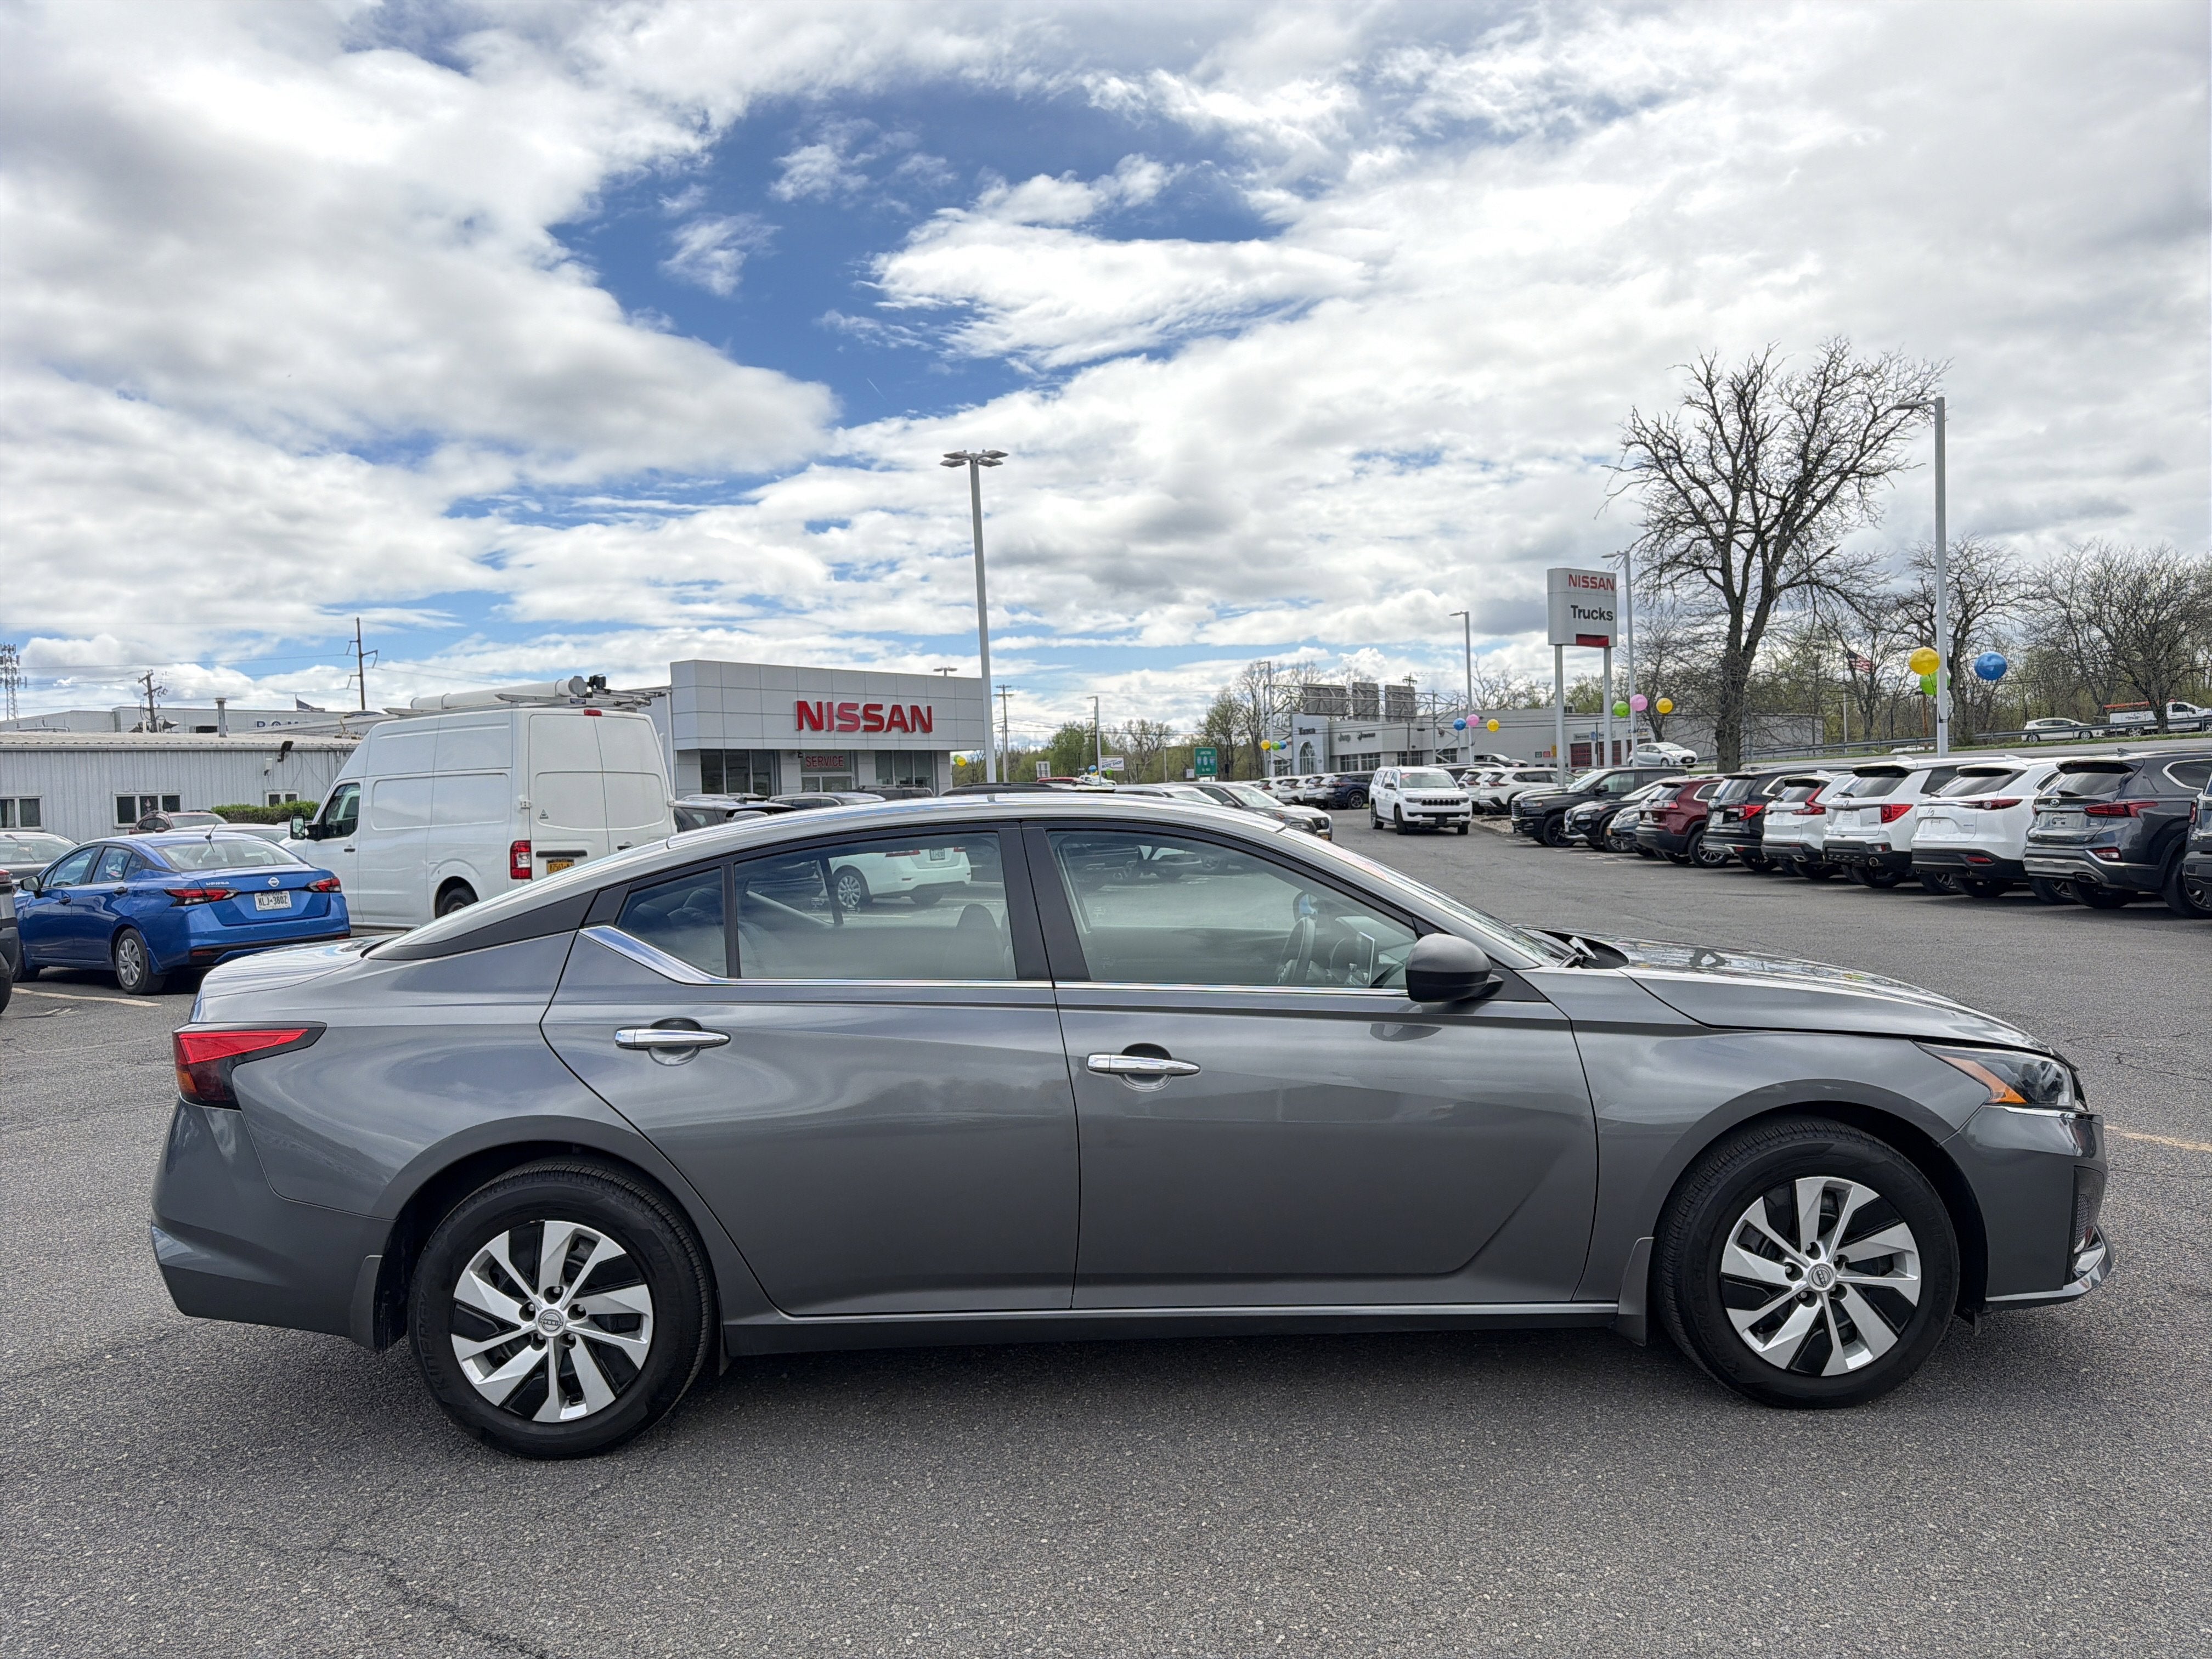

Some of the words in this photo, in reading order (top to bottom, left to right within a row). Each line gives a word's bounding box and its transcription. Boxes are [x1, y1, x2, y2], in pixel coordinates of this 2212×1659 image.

[1568, 574, 1615, 591] NISSAN
[1571, 605, 1613, 621] Trucks
[797, 700, 933, 733] NISSAN
[806, 755, 844, 768] SERVICE
